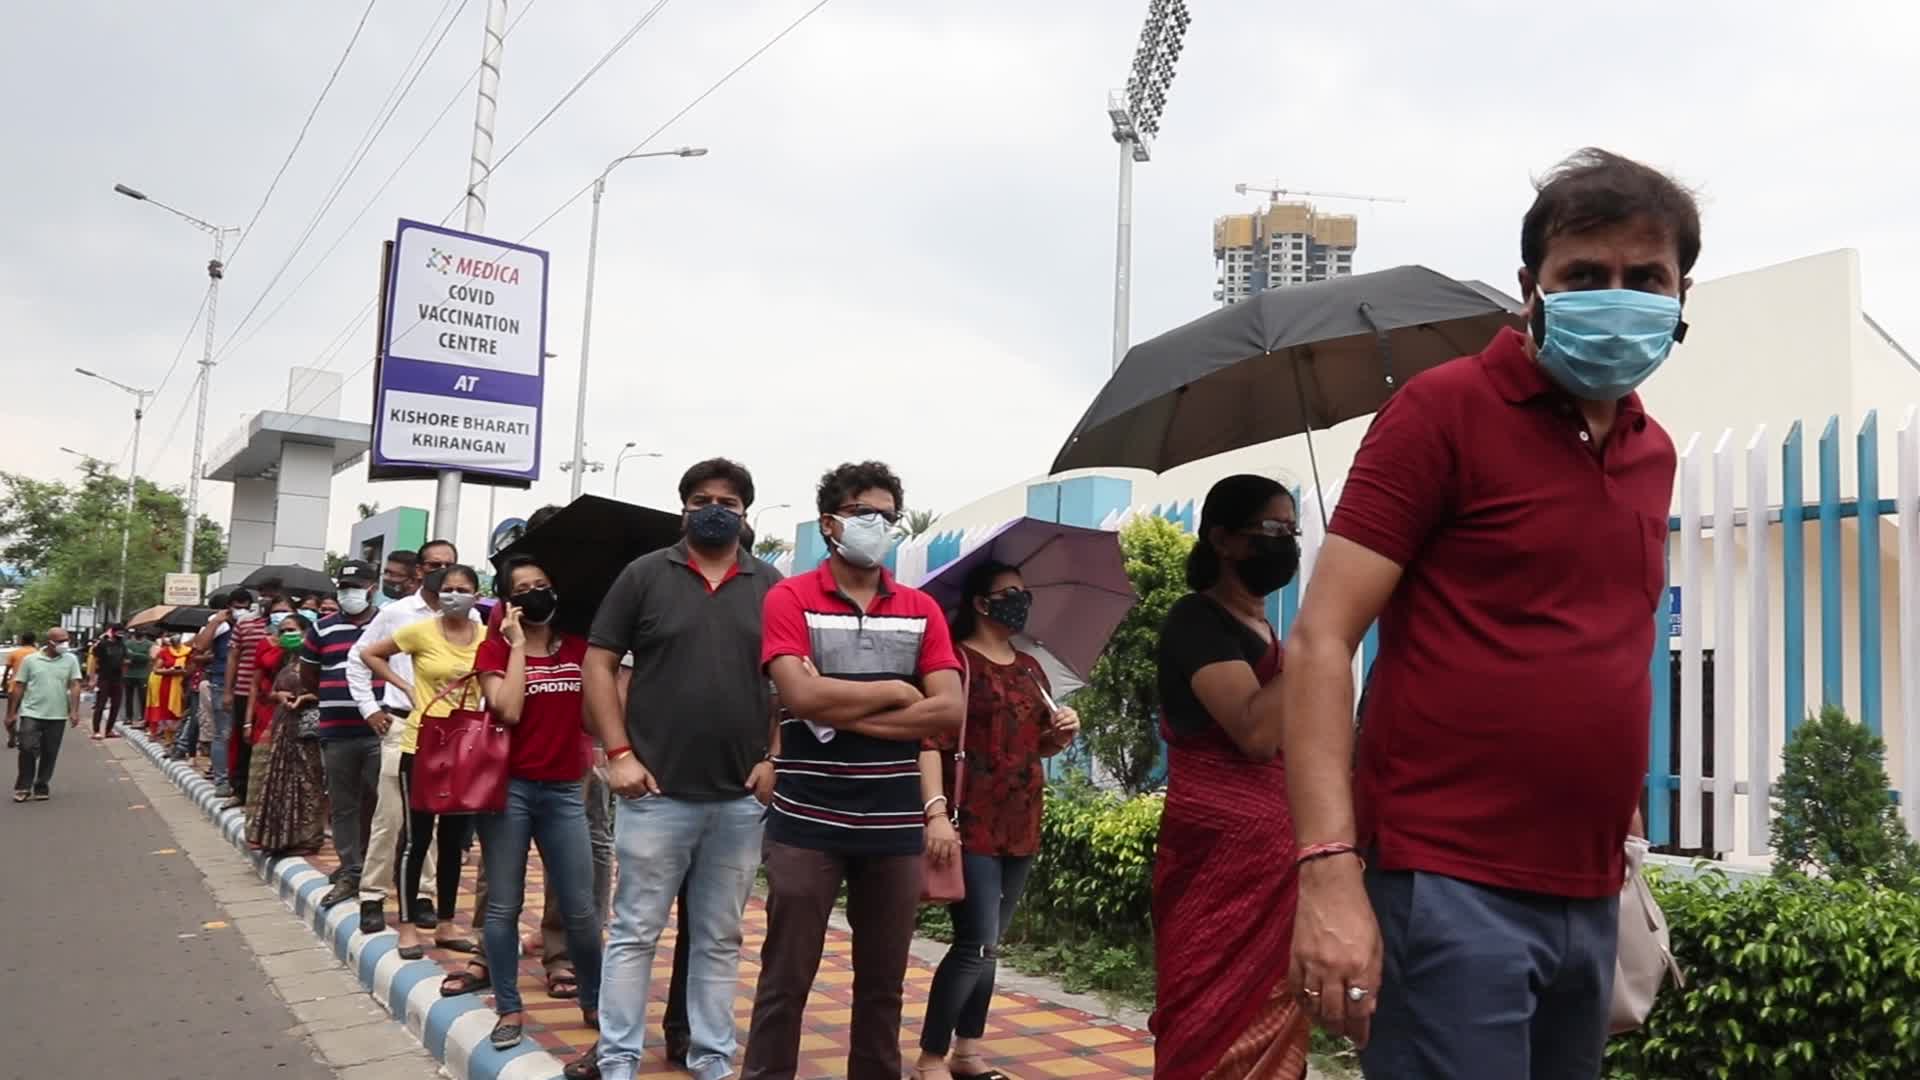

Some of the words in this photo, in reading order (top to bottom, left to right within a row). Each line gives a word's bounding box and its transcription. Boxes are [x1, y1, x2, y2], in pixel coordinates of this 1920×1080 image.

[456, 257, 520, 285] MEDICA
[448, 284, 495, 306] COVID
[418, 304, 520, 335] VACCINATION
[438, 332, 498, 355] CENTRE
[453, 375, 480, 392] AT
[390, 408, 459, 429] KISHORE
[463, 416, 530, 436] BHARATI
[412, 433, 506, 455] KRIRANGAN
